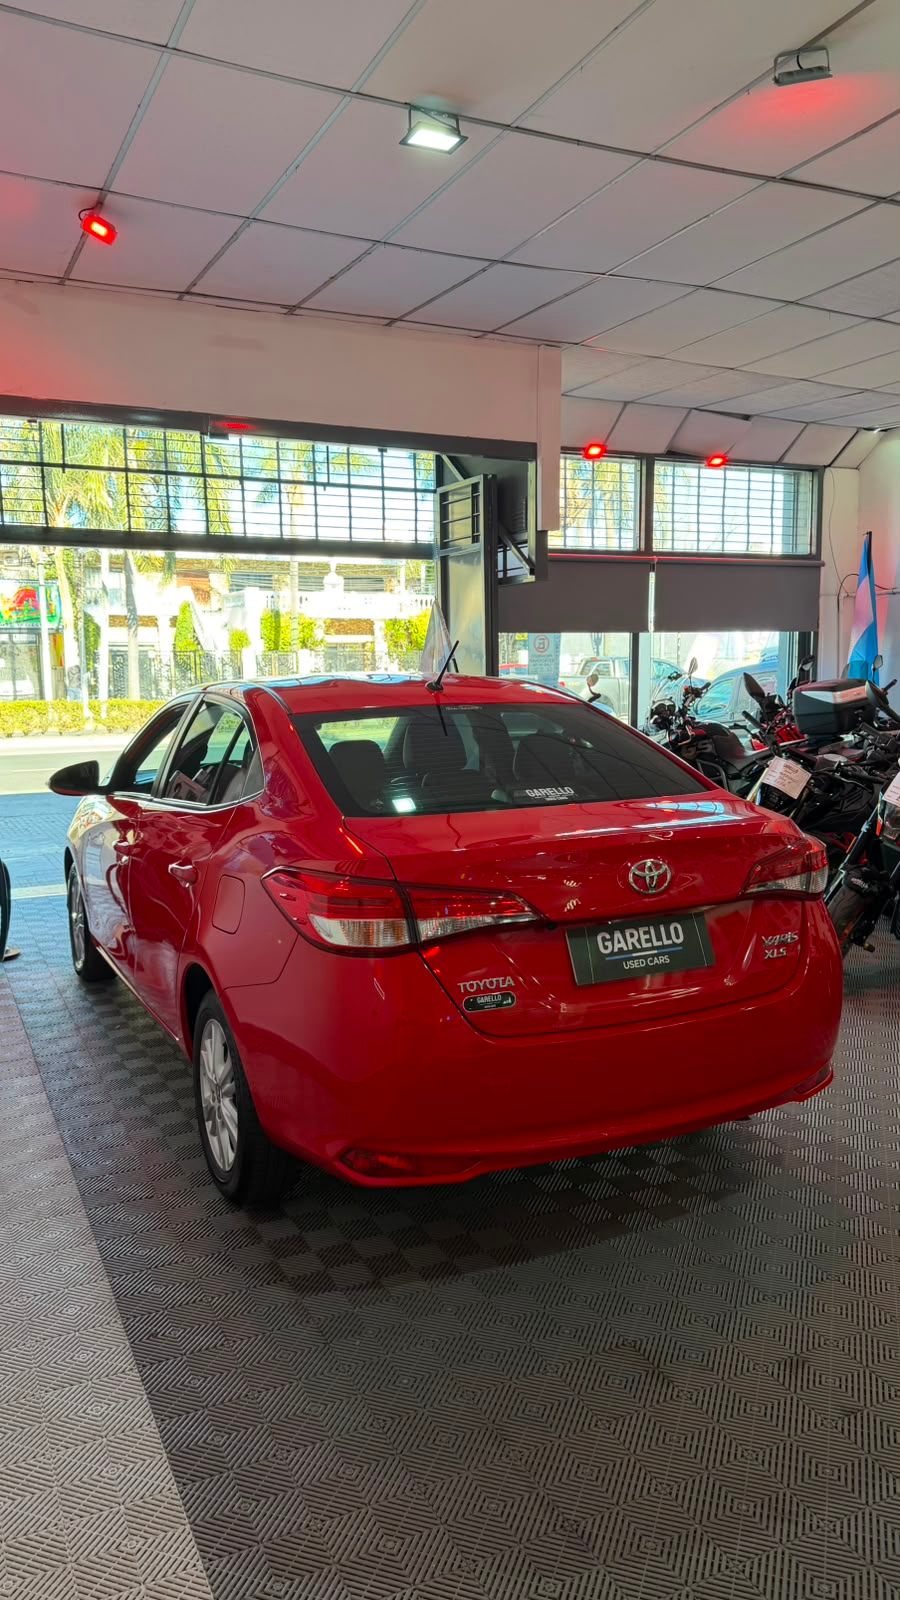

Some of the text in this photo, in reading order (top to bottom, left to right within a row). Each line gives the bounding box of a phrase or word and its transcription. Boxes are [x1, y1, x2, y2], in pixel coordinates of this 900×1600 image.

[525, 786, 575, 797] GARELLO
[596, 922, 684, 954] GARELLO
[764, 947, 787, 959] XLS
[623, 955, 670, 970] USED CARS
[457, 976, 516, 993] TOYOTA
